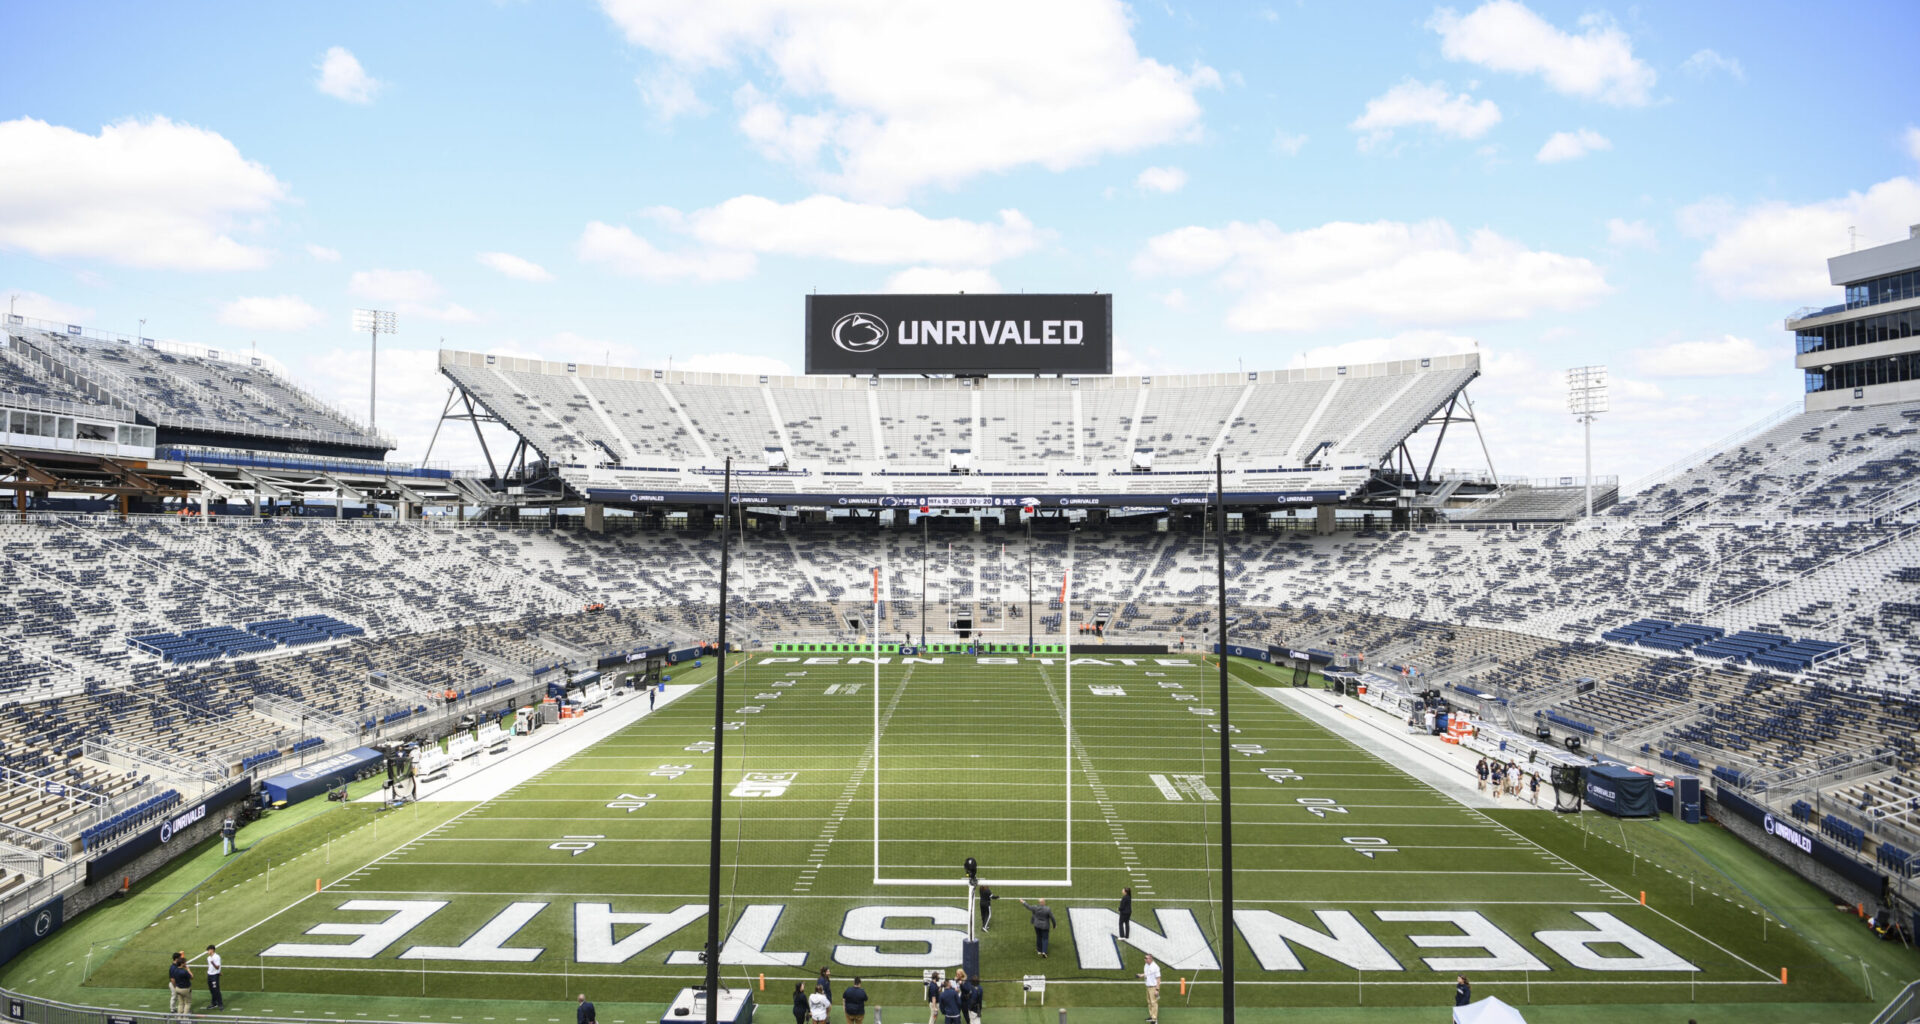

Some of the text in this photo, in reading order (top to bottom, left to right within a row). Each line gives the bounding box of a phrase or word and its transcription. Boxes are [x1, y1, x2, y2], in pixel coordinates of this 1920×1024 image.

[899, 320, 1084, 345] UNRIVALED
[757, 657, 1198, 666] PENN STATE
[605, 793, 657, 808] 20
[1296, 797, 1350, 814] 20
[172, 803, 206, 834] UNRIVALED
[548, 834, 606, 851] 10
[1342, 836, 1400, 852] 10
[1775, 821, 1812, 854] UNRIVALED
[258, 900, 1703, 972] PENN STATE
